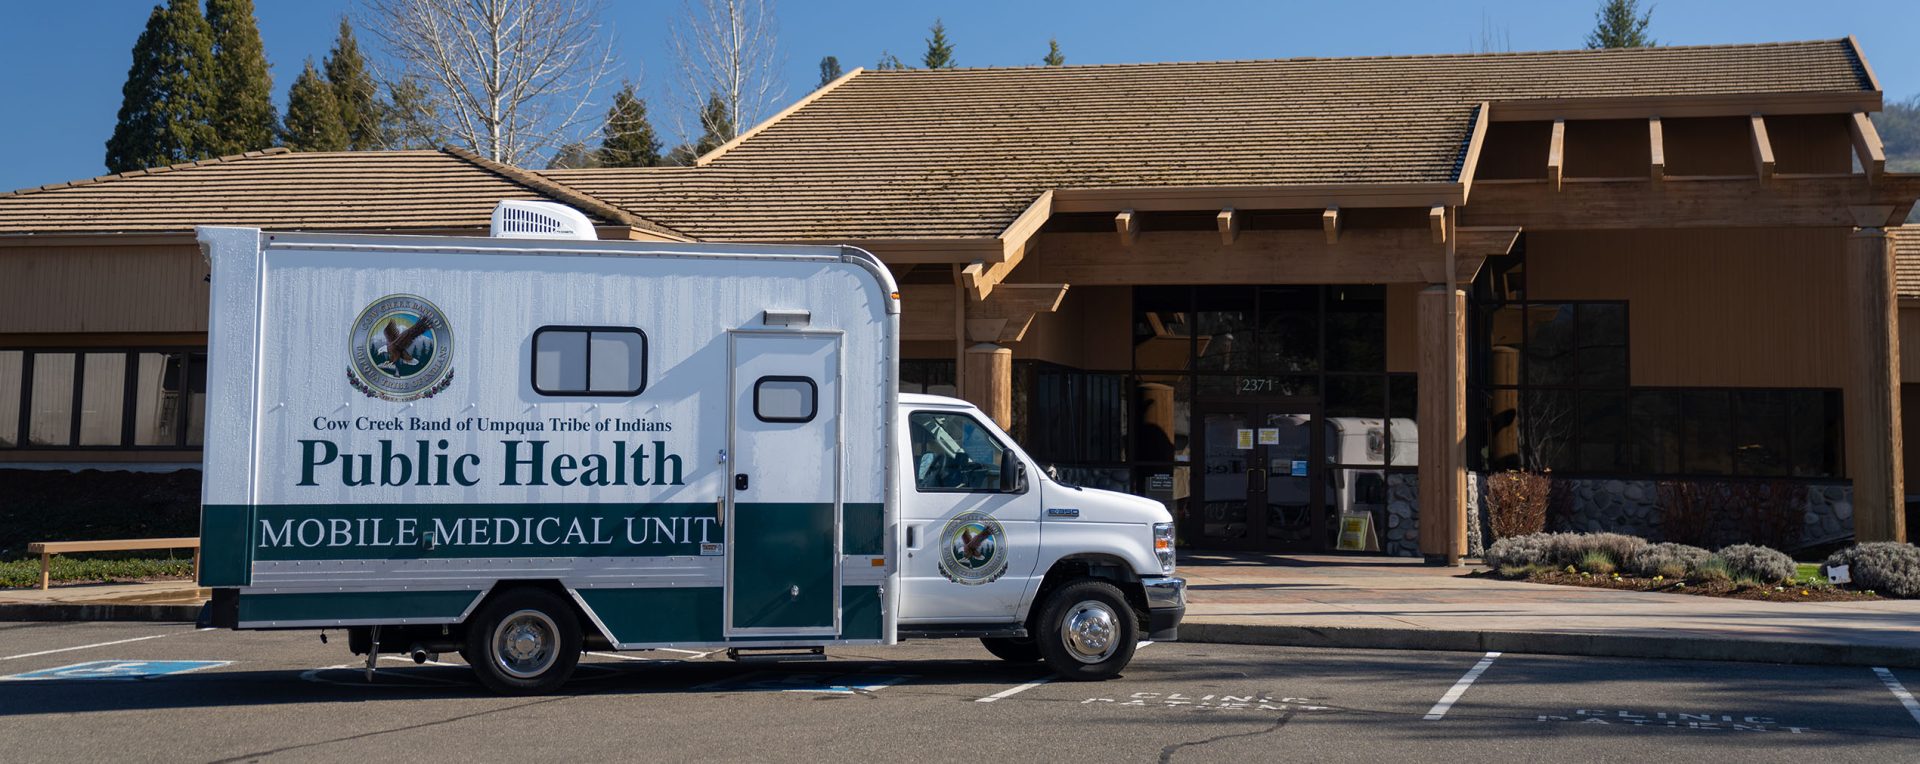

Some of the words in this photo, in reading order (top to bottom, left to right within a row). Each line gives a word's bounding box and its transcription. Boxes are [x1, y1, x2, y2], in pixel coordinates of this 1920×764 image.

[1242, 379, 1273, 391] 2371
[313, 417, 350, 431] Cow
[355, 417, 404, 431] Creek
[409, 417, 450, 431] Band
[456, 417, 473, 431] of
[477, 417, 544, 435] Umpqua
[549, 418, 590, 431] Tribe
[595, 418, 612, 432] of
[615, 418, 672, 432] Indians
[296, 439, 481, 487] Public
[499, 440, 685, 487] Health
[259, 519, 418, 548] MOBILE
[433, 518, 612, 545] MEDICAL
[624, 516, 717, 545] UNIT
[1130, 692, 1308, 704] CLINIC
[1537, 715, 1810, 734] PATIENT
[1576, 709, 1776, 724] CLINIC
